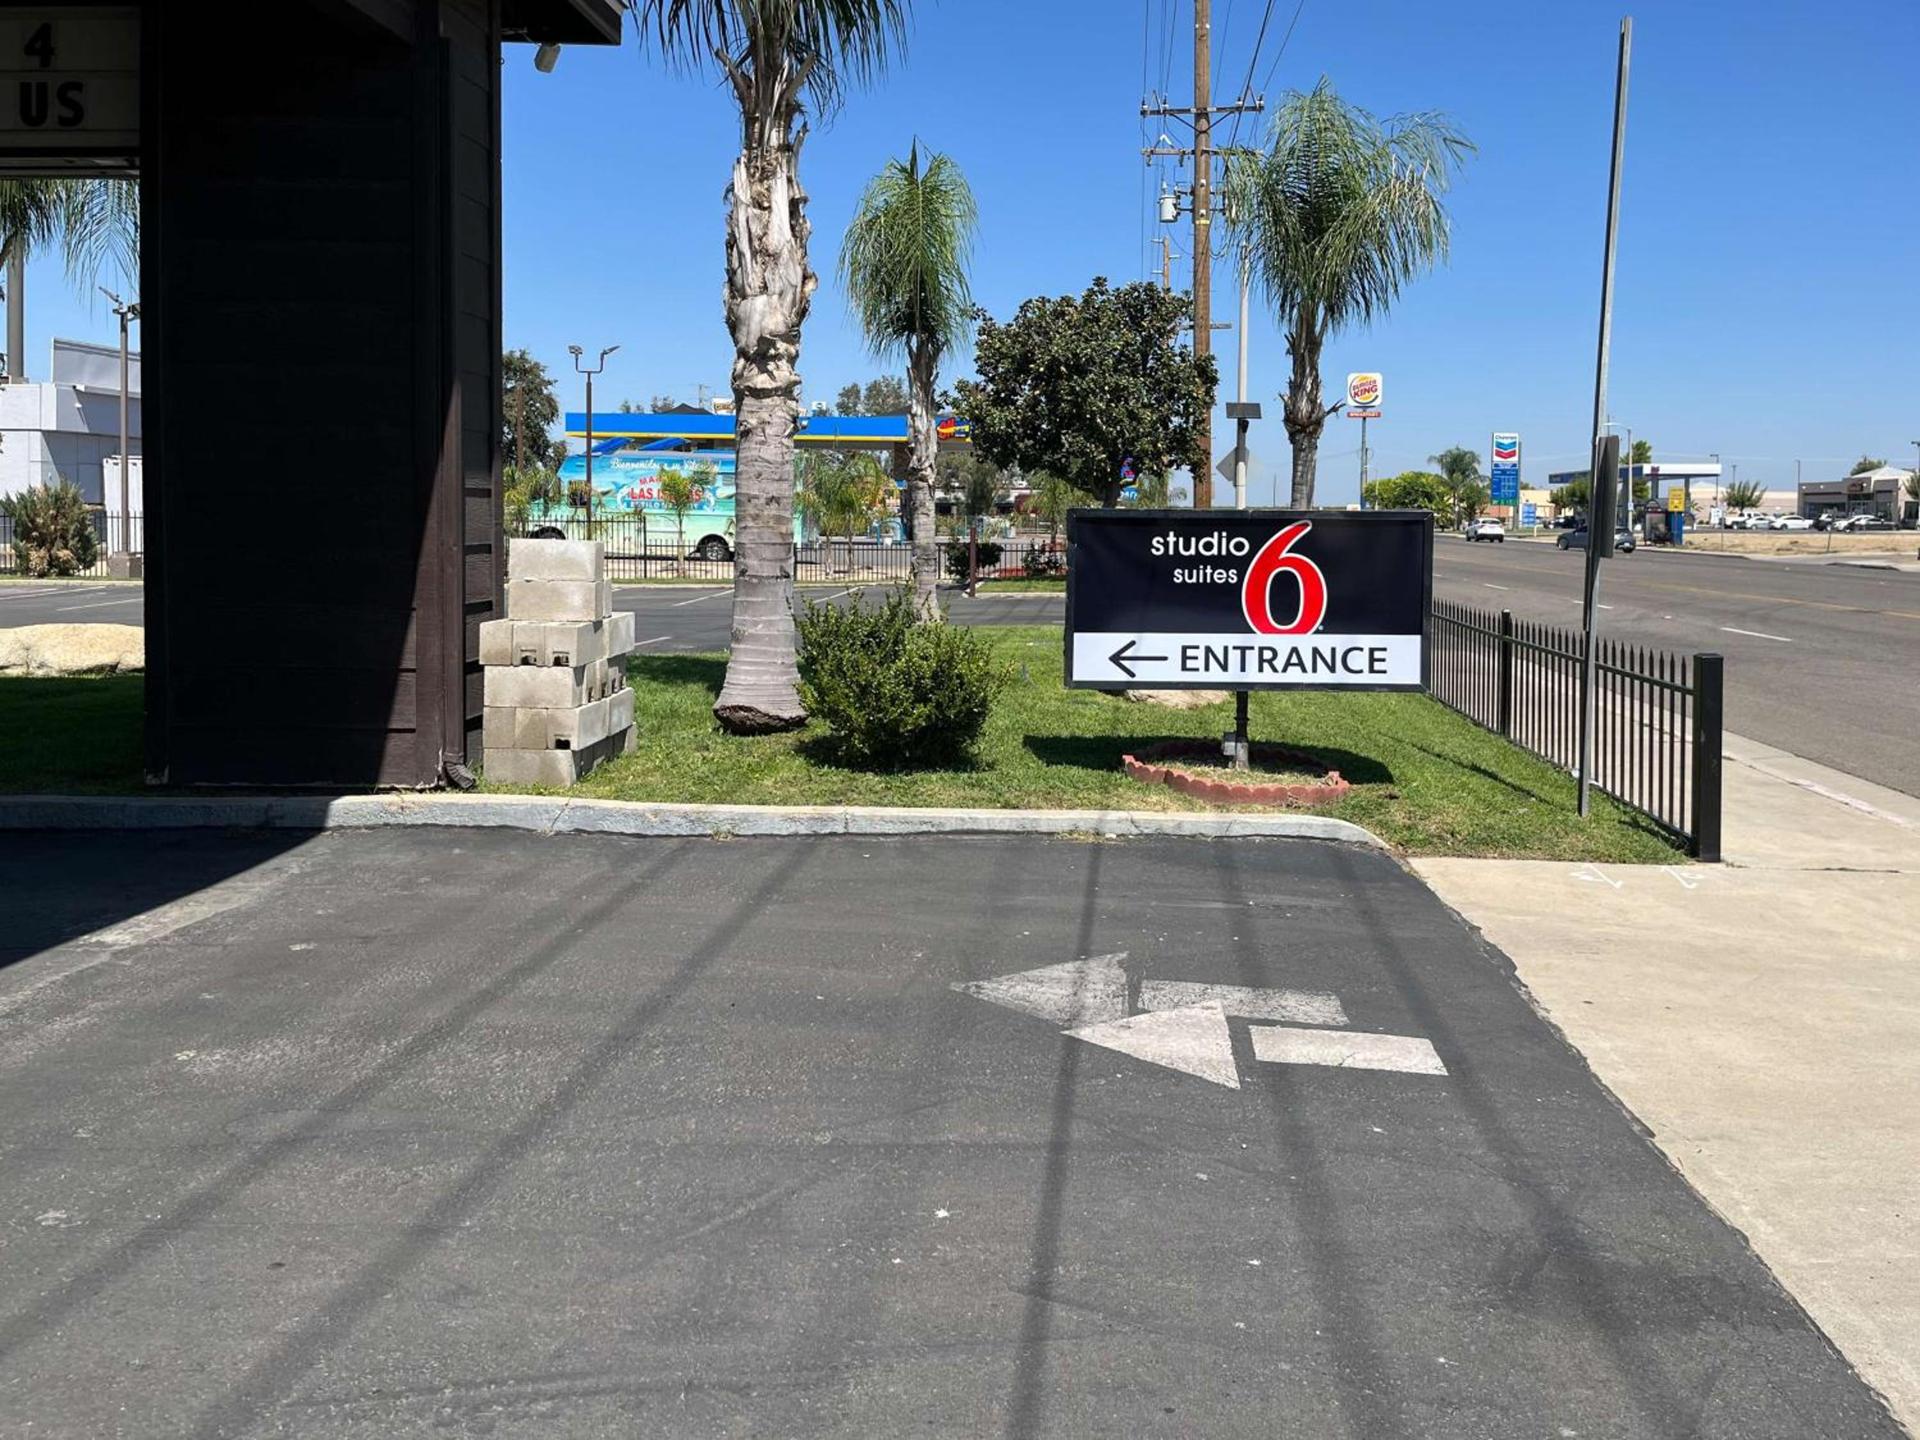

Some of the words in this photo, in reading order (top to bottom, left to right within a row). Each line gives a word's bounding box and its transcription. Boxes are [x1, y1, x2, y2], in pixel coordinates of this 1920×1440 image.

[24, 22, 55, 68] 4
[19, 82, 84, 127] US
[1353, 385, 1378, 399] KING
[630, 487, 654, 500] LAS
[1150, 531, 1250, 557] studio
[1241, 520, 1328, 635] 6
[1173, 564, 1238, 584] suites
[1180, 645, 1388, 675] ENTRANCE
